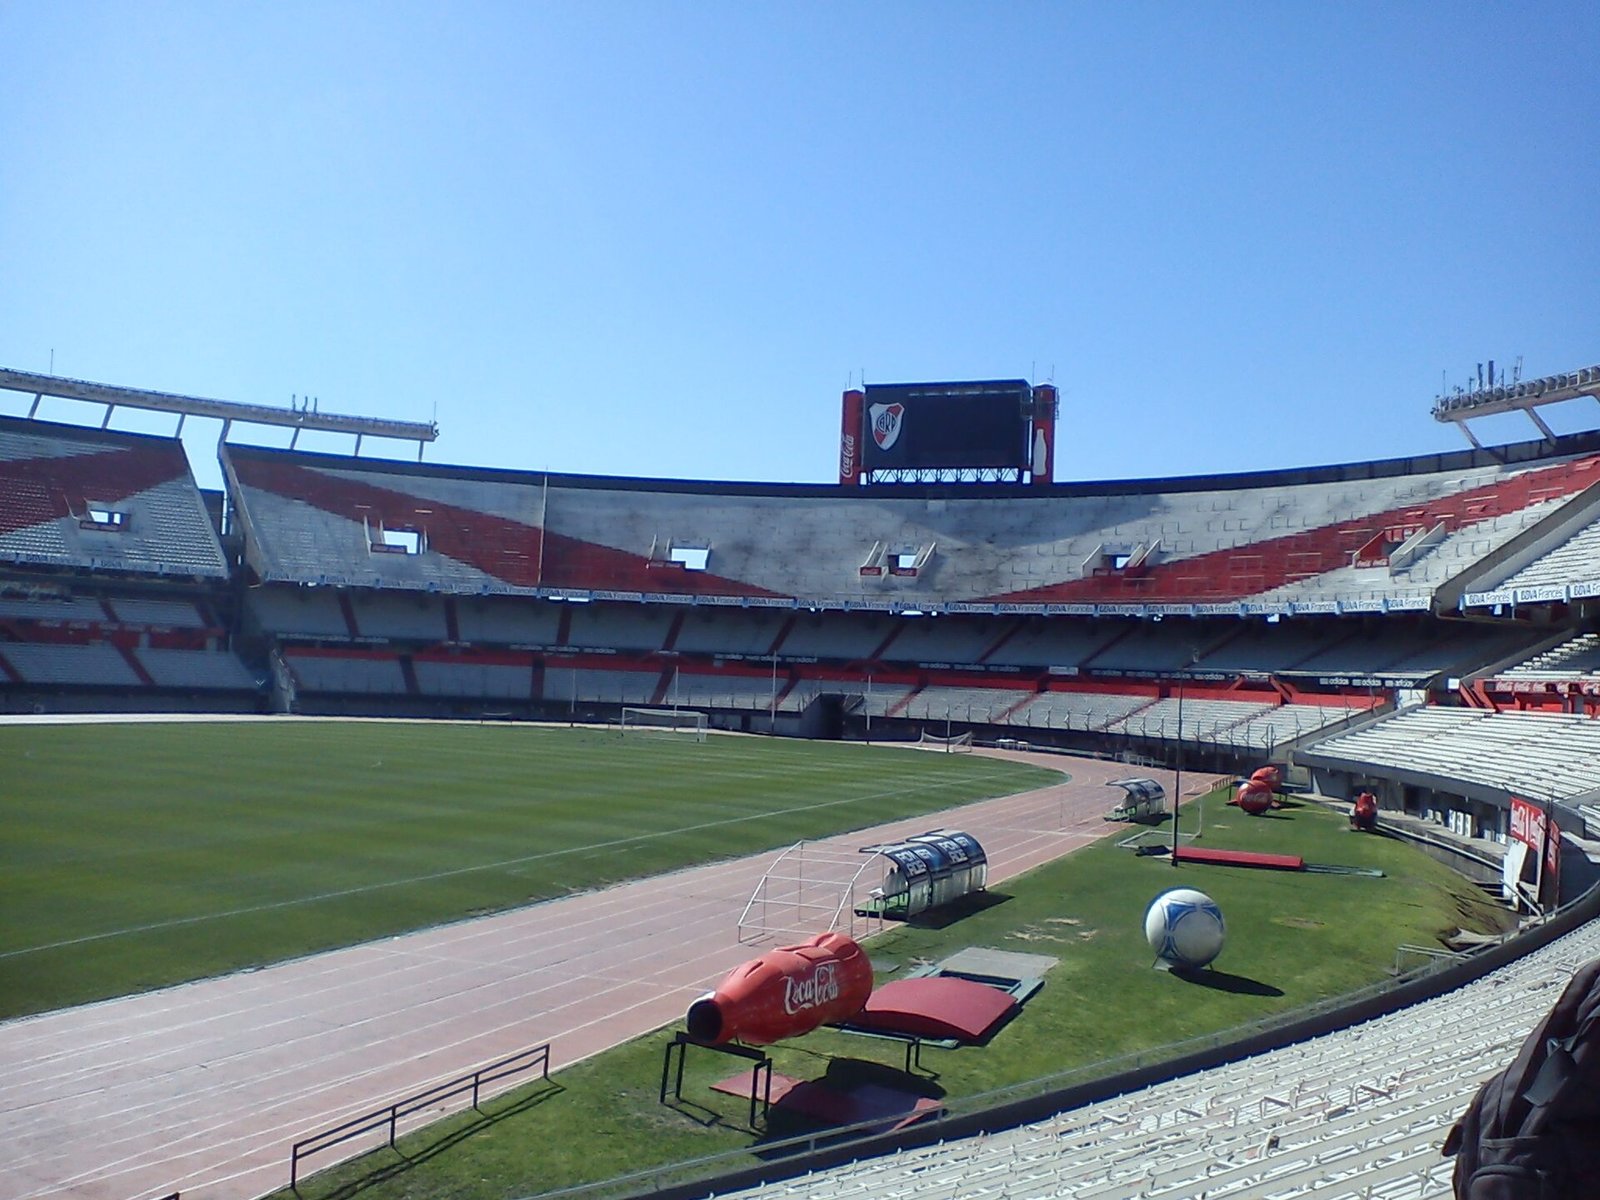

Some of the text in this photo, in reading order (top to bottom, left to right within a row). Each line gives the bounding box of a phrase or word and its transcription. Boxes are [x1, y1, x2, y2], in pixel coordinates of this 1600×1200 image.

[1520, 588, 1564, 600] BBVA Francés
[1573, 585, 1591, 597] BBVA
[1469, 593, 1510, 604] BBVA Francés
[780, 964, 839, 1015] Coca-Cola
